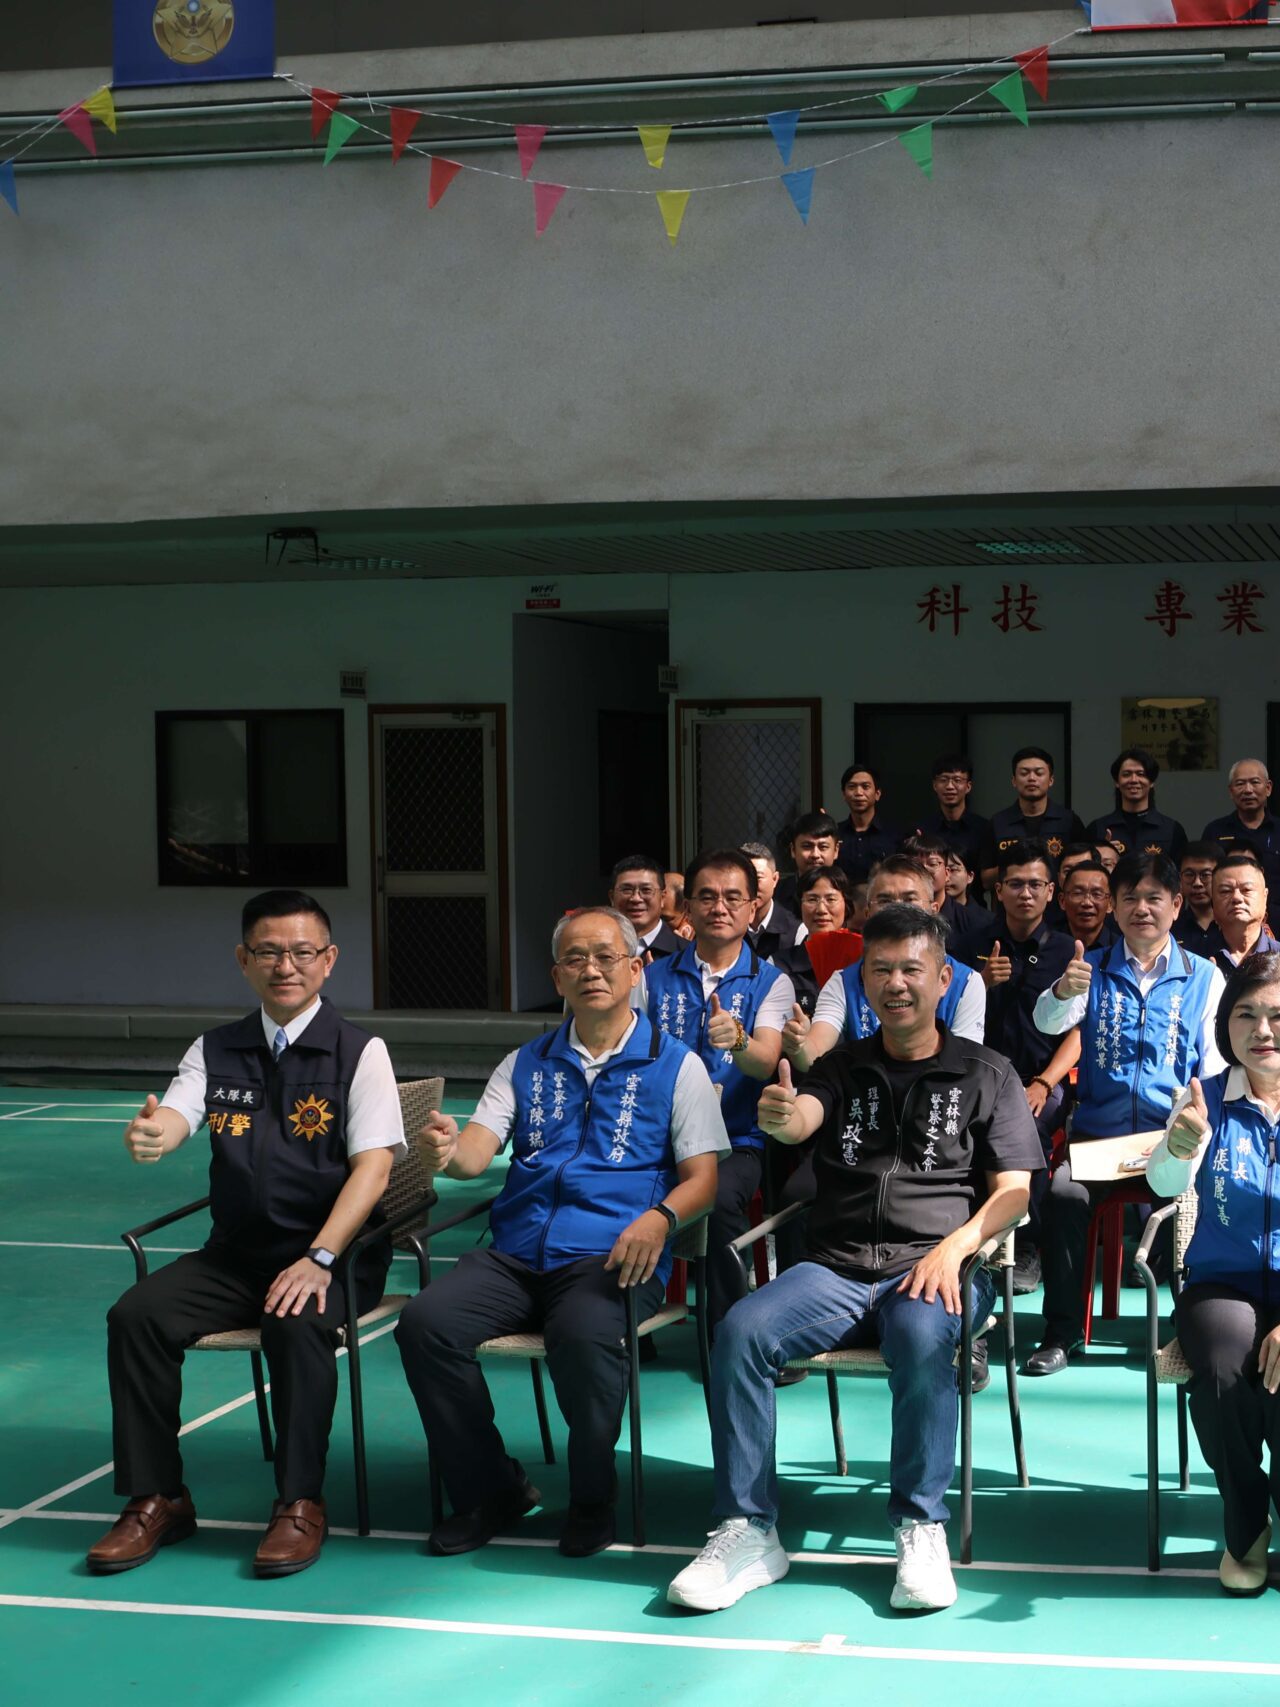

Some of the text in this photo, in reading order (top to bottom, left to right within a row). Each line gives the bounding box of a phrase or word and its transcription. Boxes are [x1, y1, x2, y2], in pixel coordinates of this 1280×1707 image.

[917, 585, 1043, 636] 科技
[1144, 582, 1264, 636] 專業
[213, 1088, 254, 1104] 大隊長
[524, 1071, 546, 1163] 副局長陳瑞
[552, 1072, 567, 1120] 警察局
[607, 1074, 642, 1163] 雲林縣政府
[866, 1086, 880, 1131] 理事長
[945, 1087, 963, 1136] 雲林縣
[208, 1112, 251, 1136] 刑警
[842, 1097, 863, 1167] 吳政憲
[1234, 1137, 1252, 1181] 縣長
